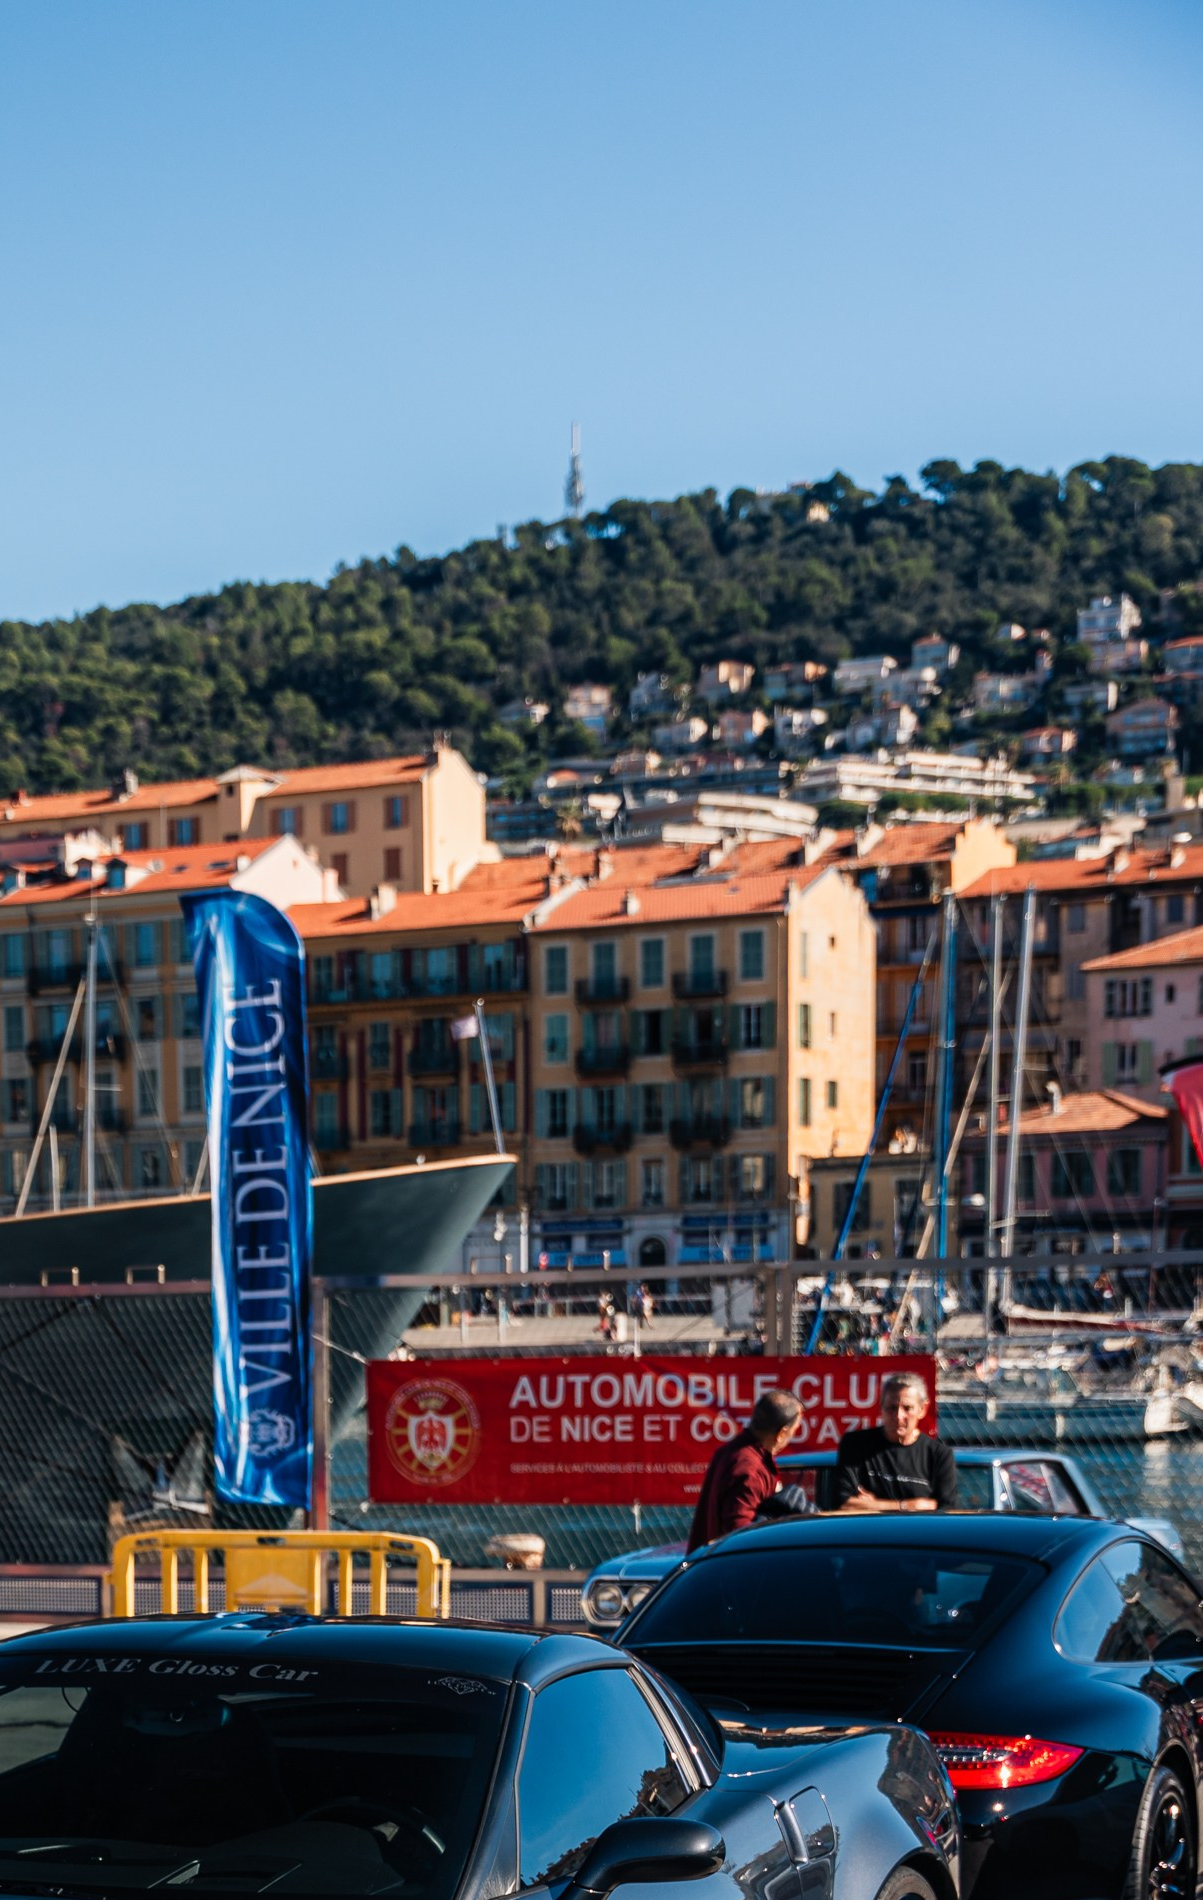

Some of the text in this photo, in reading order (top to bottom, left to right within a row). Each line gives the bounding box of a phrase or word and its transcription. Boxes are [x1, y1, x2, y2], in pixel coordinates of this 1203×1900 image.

[223, 978, 292, 1398] VILLE DE NICE
[509, 1372, 779, 1409] AUTOMOBILE
[791, 1372, 896, 1409] CLU
[510, 1415, 553, 1443] DE
[561, 1414, 635, 1442] NICE
[643, 1414, 684, 1442] ET
[35, 1658, 319, 1682] LUXE Gloss Car
